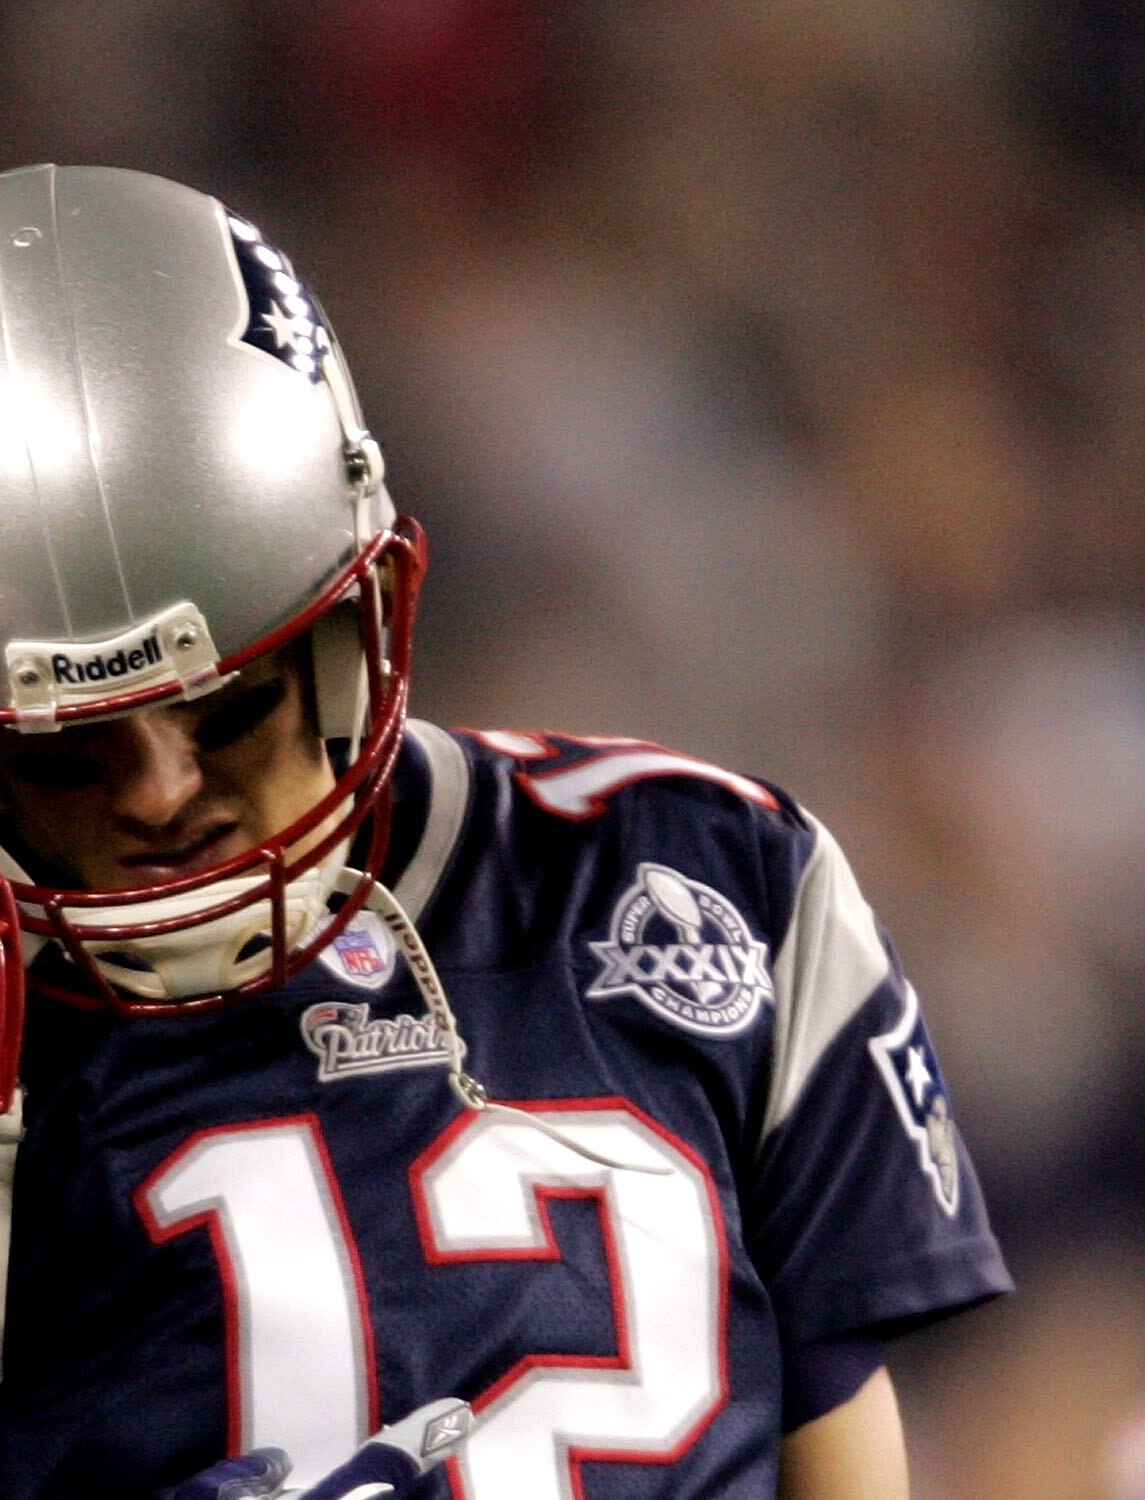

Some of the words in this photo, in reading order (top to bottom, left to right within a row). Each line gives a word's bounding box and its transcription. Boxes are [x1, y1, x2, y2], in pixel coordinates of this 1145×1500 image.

[52, 634, 162, 684] Riddell
[621, 895, 651, 943] SUPER
[698, 894, 744, 943] BOWL
[383, 911, 451, 1031] Riddell
[609, 943, 772, 990] XXXIX
[650, 985, 753, 1024] CHAMPIONS
[312, 1015, 458, 1072] Patriot
